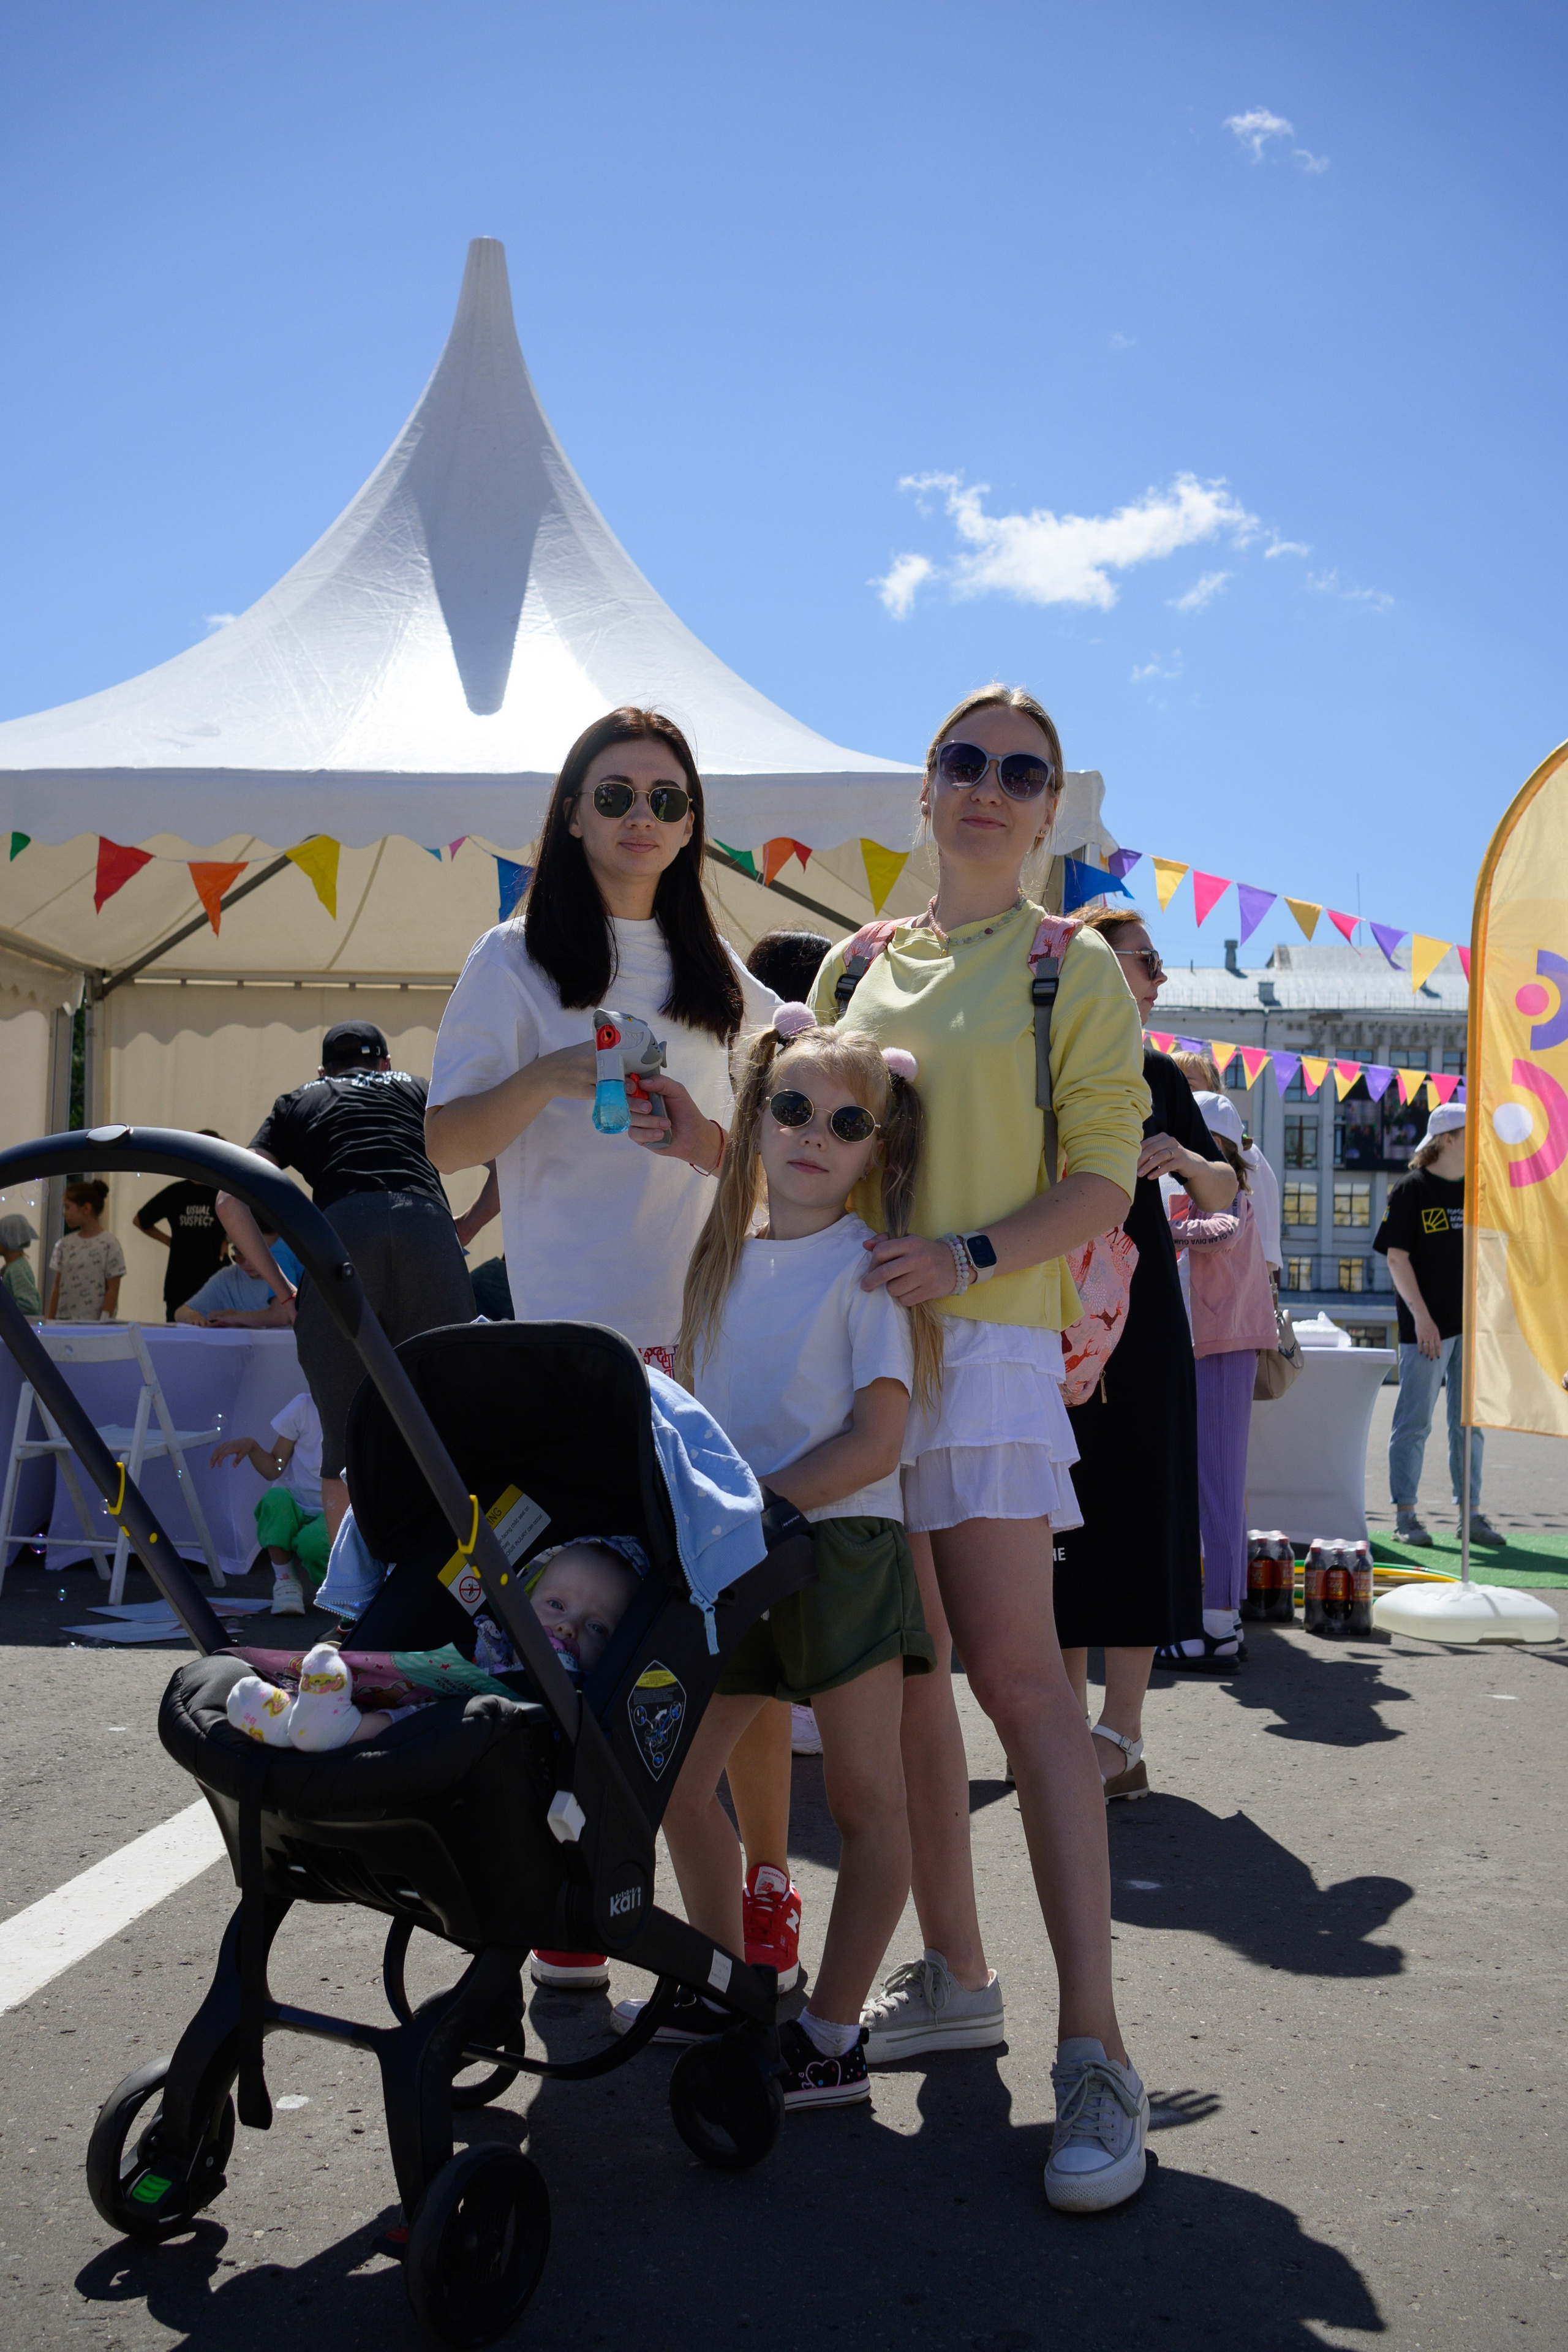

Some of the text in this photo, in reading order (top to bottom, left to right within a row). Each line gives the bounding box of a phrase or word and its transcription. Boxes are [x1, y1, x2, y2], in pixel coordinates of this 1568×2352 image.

[186, 1204, 210, 1216] USUAL
[179, 1214, 214, 1229] SUSPECT
[510, 1518, 519, 1528] child
[514, 1530, 528, 1547] INJURY
[533, 1513, 543, 1526] occur
